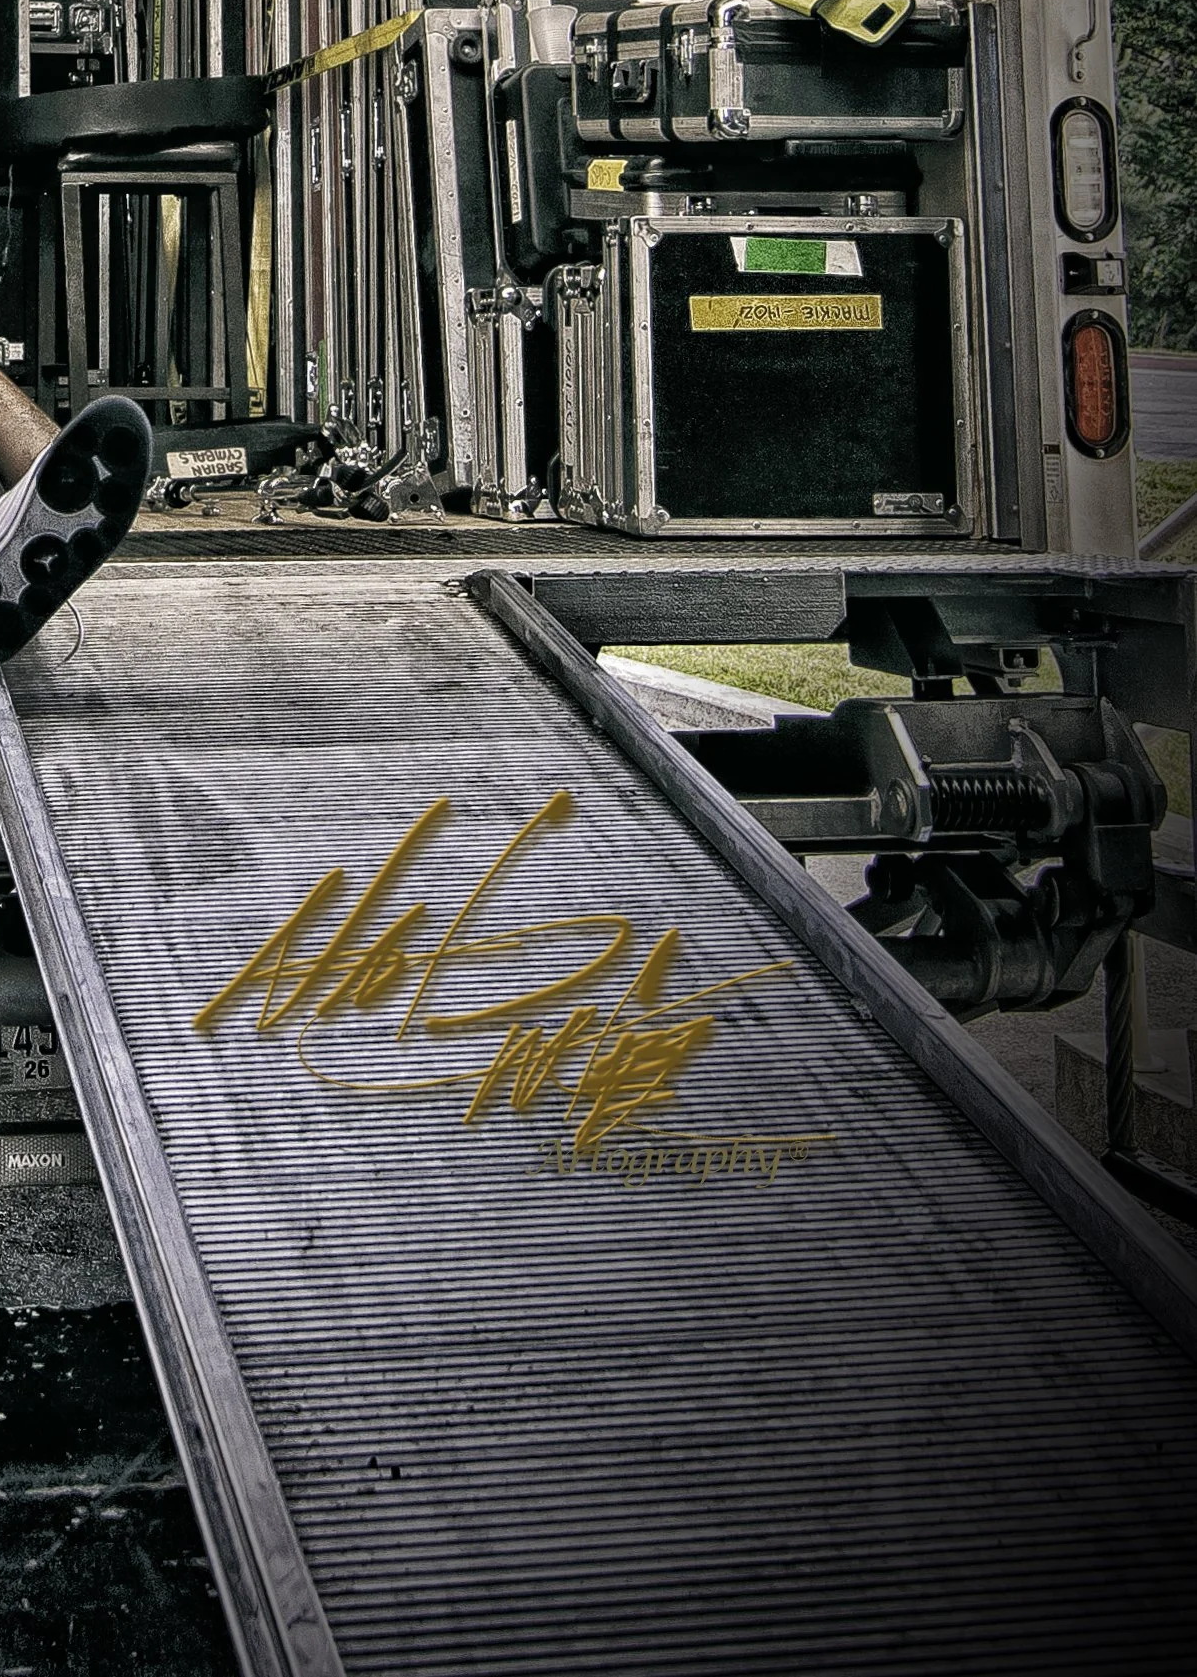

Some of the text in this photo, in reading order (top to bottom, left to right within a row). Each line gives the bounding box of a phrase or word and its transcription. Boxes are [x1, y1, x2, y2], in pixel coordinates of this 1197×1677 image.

[802, 304, 870, 322] MACKIE
[178, 449, 243, 465] CYMBALS
[191, 461, 243, 476] SABIAN
[25, 1060, 50, 1079] 26
[8, 1151, 65, 1170] MAXON
